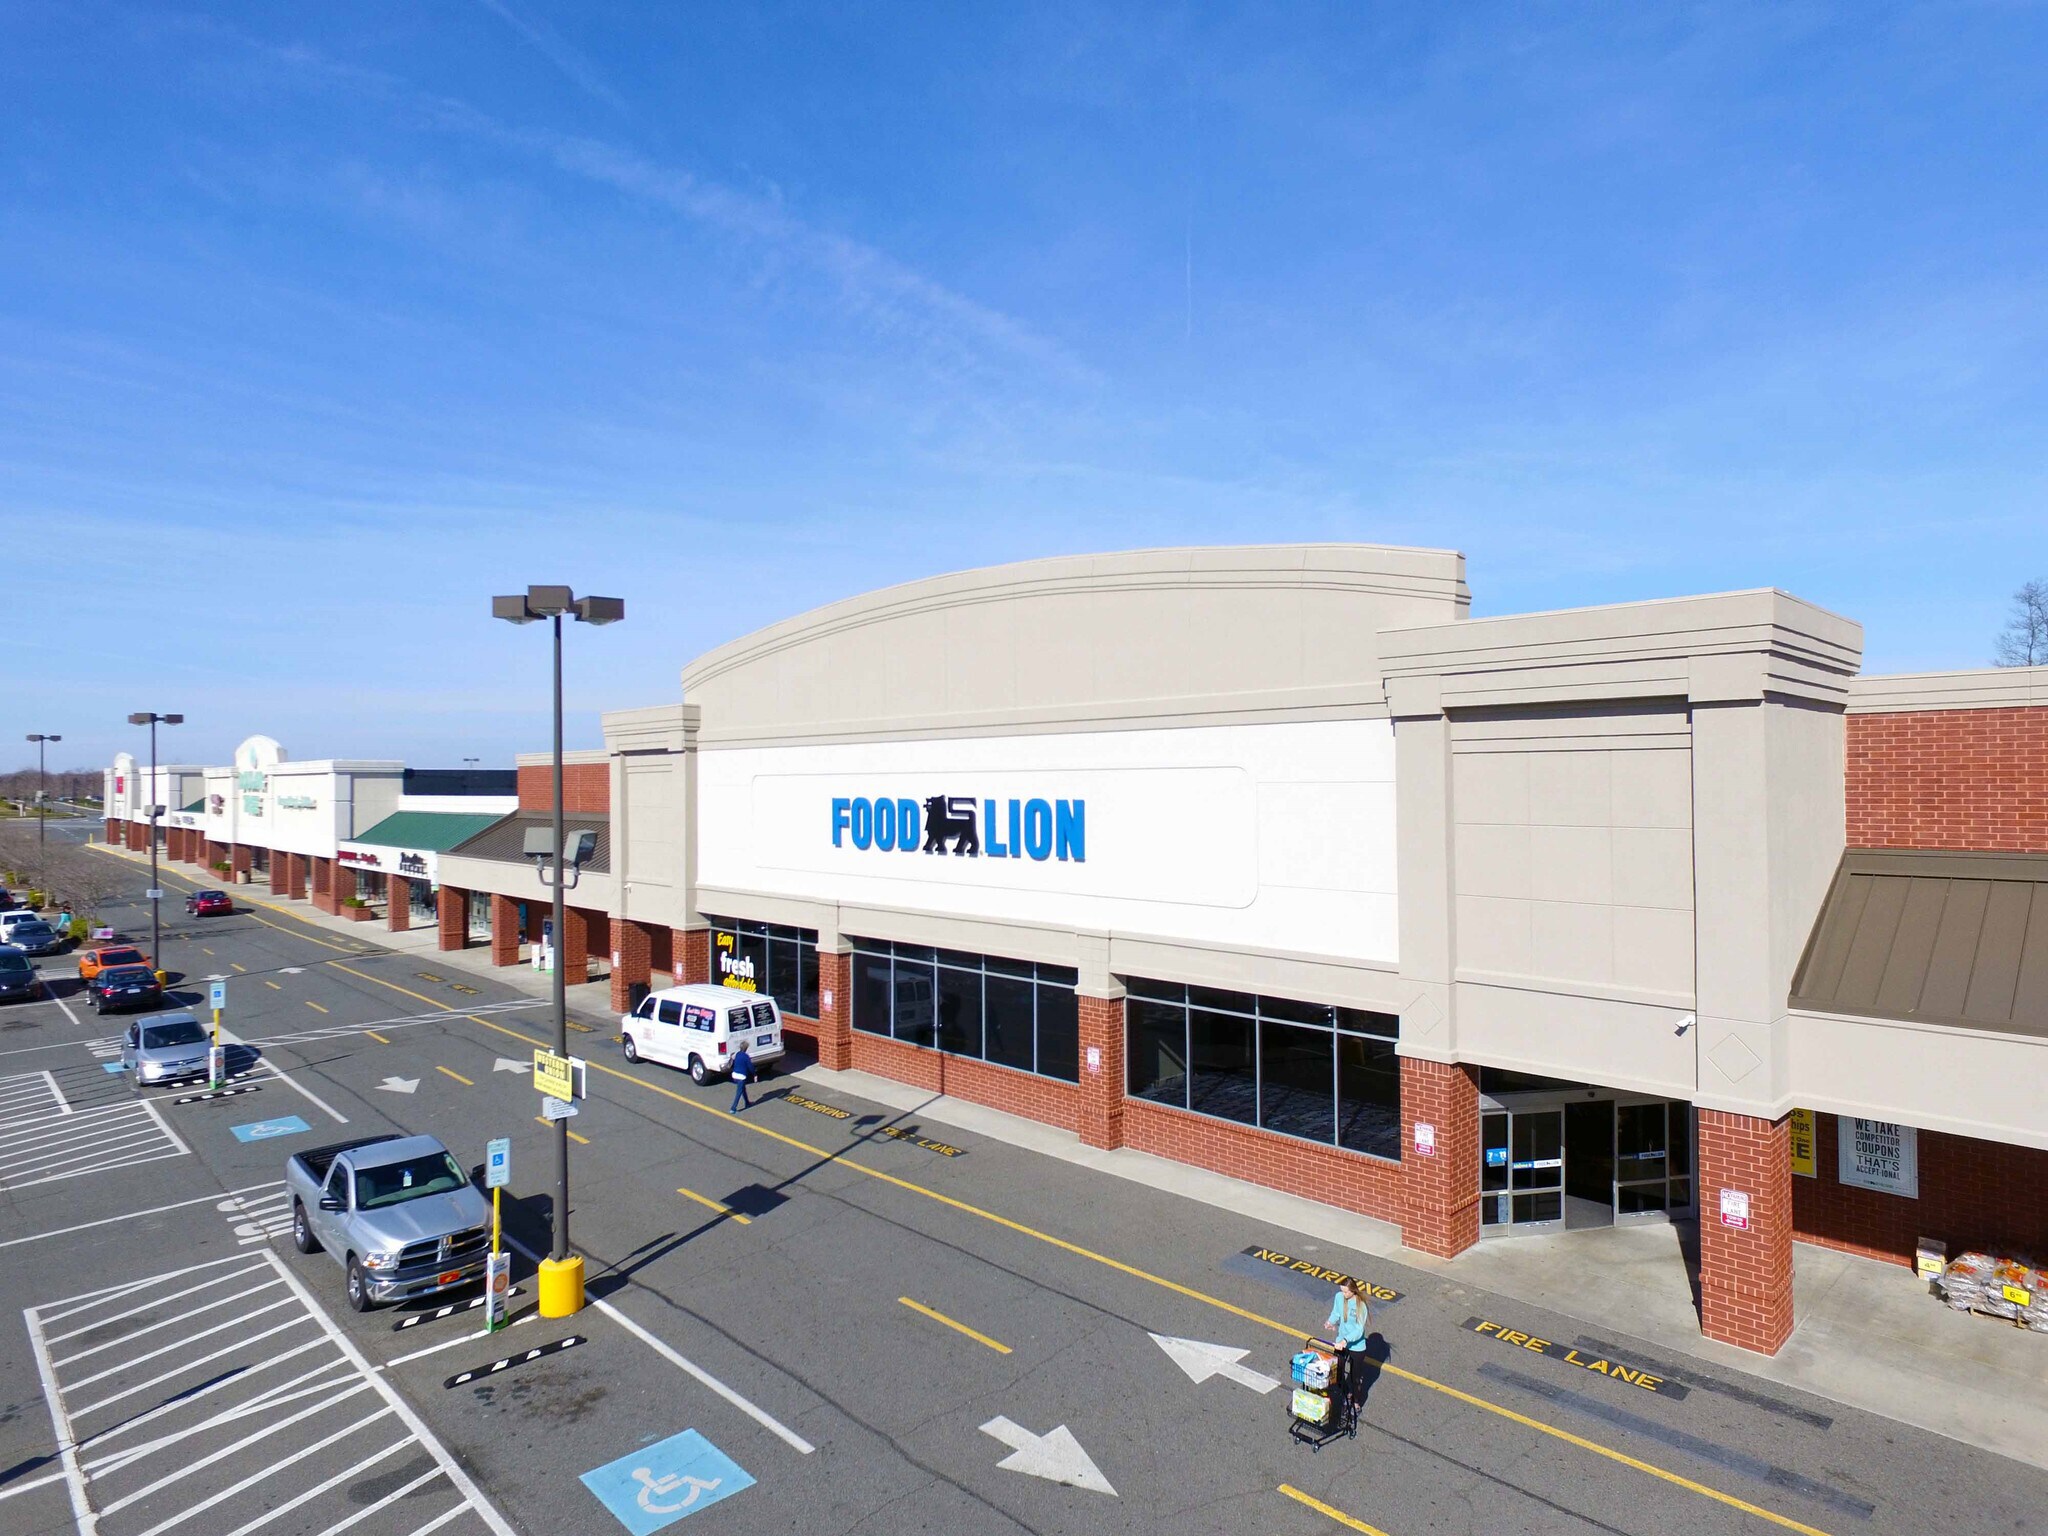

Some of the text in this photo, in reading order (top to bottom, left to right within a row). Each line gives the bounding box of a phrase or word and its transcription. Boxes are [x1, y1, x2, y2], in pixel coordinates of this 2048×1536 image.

[832, 797, 1086, 863] FOOD LION
[717, 932, 734, 953] Easy
[720, 951, 755, 978] fresh
[801, 1100, 850, 1119] PARKING
[1791, 1119, 1810, 1133] hips
[1855, 1117, 1900, 1137] WE TAKE
[917, 1139, 962, 1157] LANE
[1855, 1131, 1900, 1147] COMPETITOR
[1855, 1140, 1900, 1159] COUPONS
[1856, 1154, 1900, 1172] THAT'S
[1253, 1248, 1288, 1266] NO
[1474, 1320, 1664, 1392] FIRE LANE
